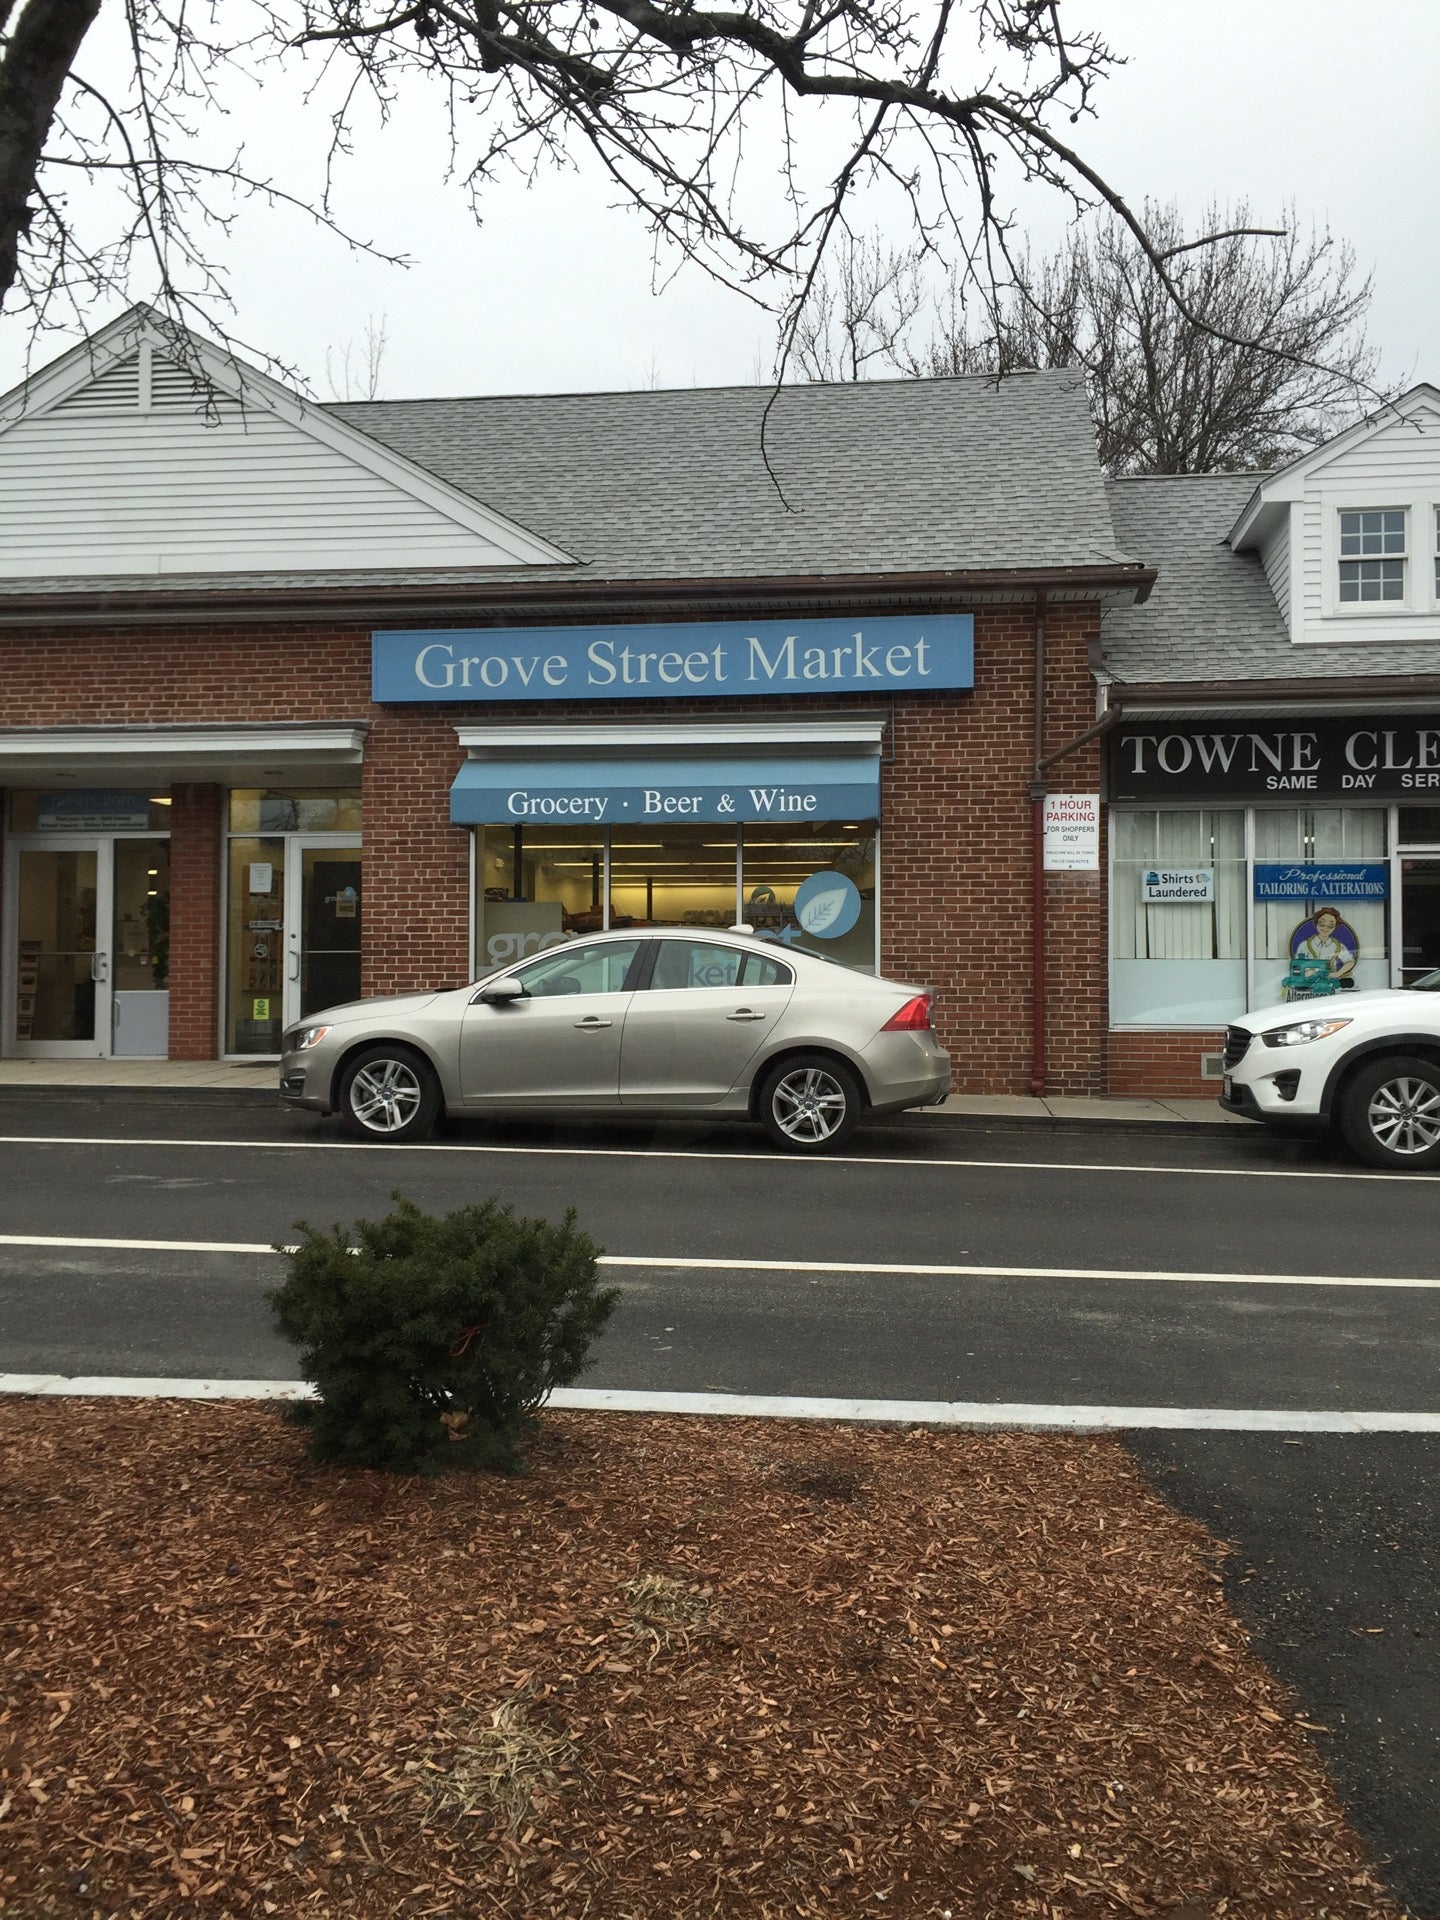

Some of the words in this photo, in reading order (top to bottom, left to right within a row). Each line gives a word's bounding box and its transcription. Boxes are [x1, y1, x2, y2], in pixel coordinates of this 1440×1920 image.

[414, 644, 568, 689] Grove
[587, 640, 728, 685] Street
[744, 632, 931, 681] Market
[1120, 733, 1321, 774] TOWNE
[1266, 775, 1318, 790] SAME
[1341, 774, 1377, 789] DAY
[507, 791, 609, 821] Grocery
[643, 790, 703, 814] Beer
[716, 793, 736, 813] &
[748, 788, 817, 812] Wine
[1059, 800, 1092, 810] HOUR
[1046, 812, 1096, 822] PARKING
[1047, 825, 1060, 833] FOR
[1061, 825, 1095, 833] SHOPPERS
[1062, 834, 1079, 842] ONLY
[1161, 873, 1194, 884] Shirts
[1279, 868, 1367, 883] Professional
[1148, 886, 1207, 898] Laundered
[1257, 882, 1309, 895] TAILORING
[1320, 882, 1385, 895] ALTERATIONS
